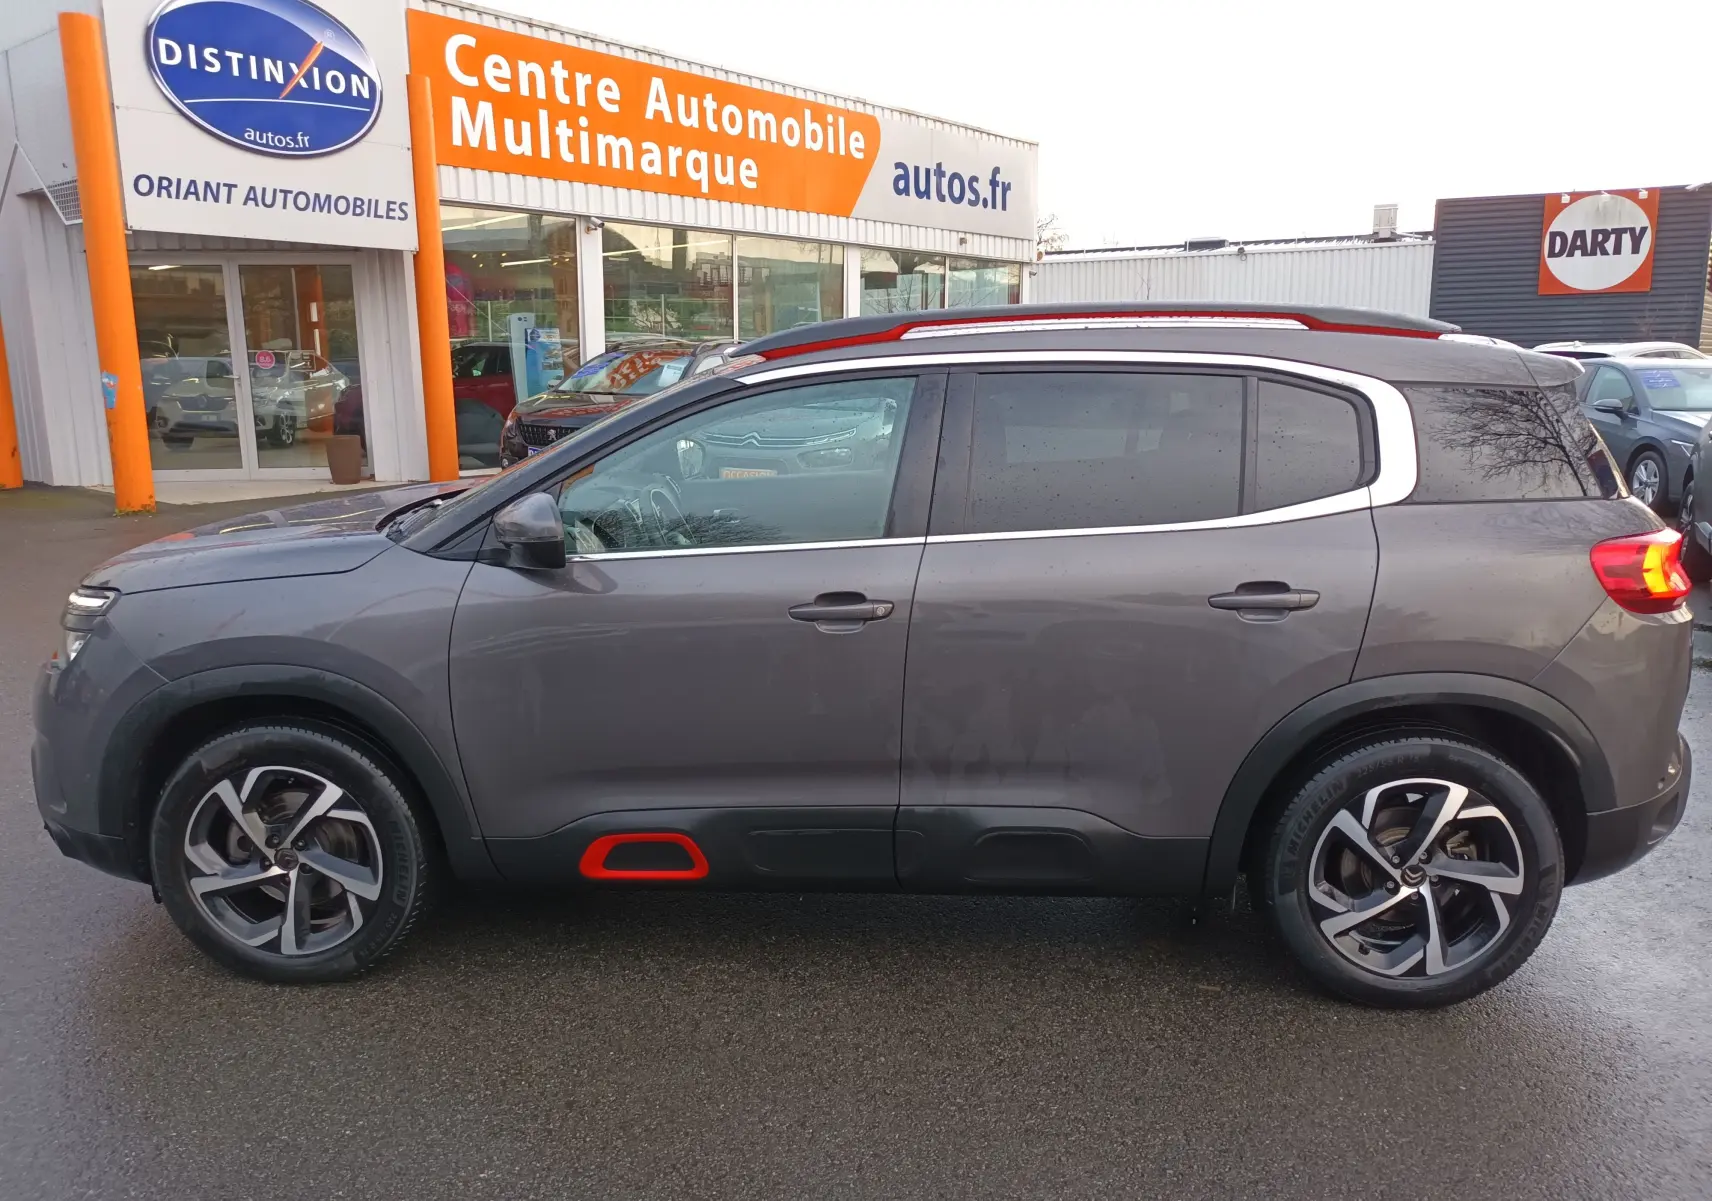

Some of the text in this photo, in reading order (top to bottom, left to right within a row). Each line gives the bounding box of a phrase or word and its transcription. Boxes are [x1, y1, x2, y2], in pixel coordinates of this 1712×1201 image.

[157, 37, 370, 99] DISTINXION
[444, 33, 866, 160] Centre Automobile
[243, 127, 311, 149] autos.fr
[451, 95, 759, 194] Multimarque
[132, 173, 409, 222] ORIANT AUTOMOBILES
[892, 161, 1012, 212] autos.fr
[1547, 226, 1649, 259] DARTY
[1287, 779, 1345, 856] MICHELIN
